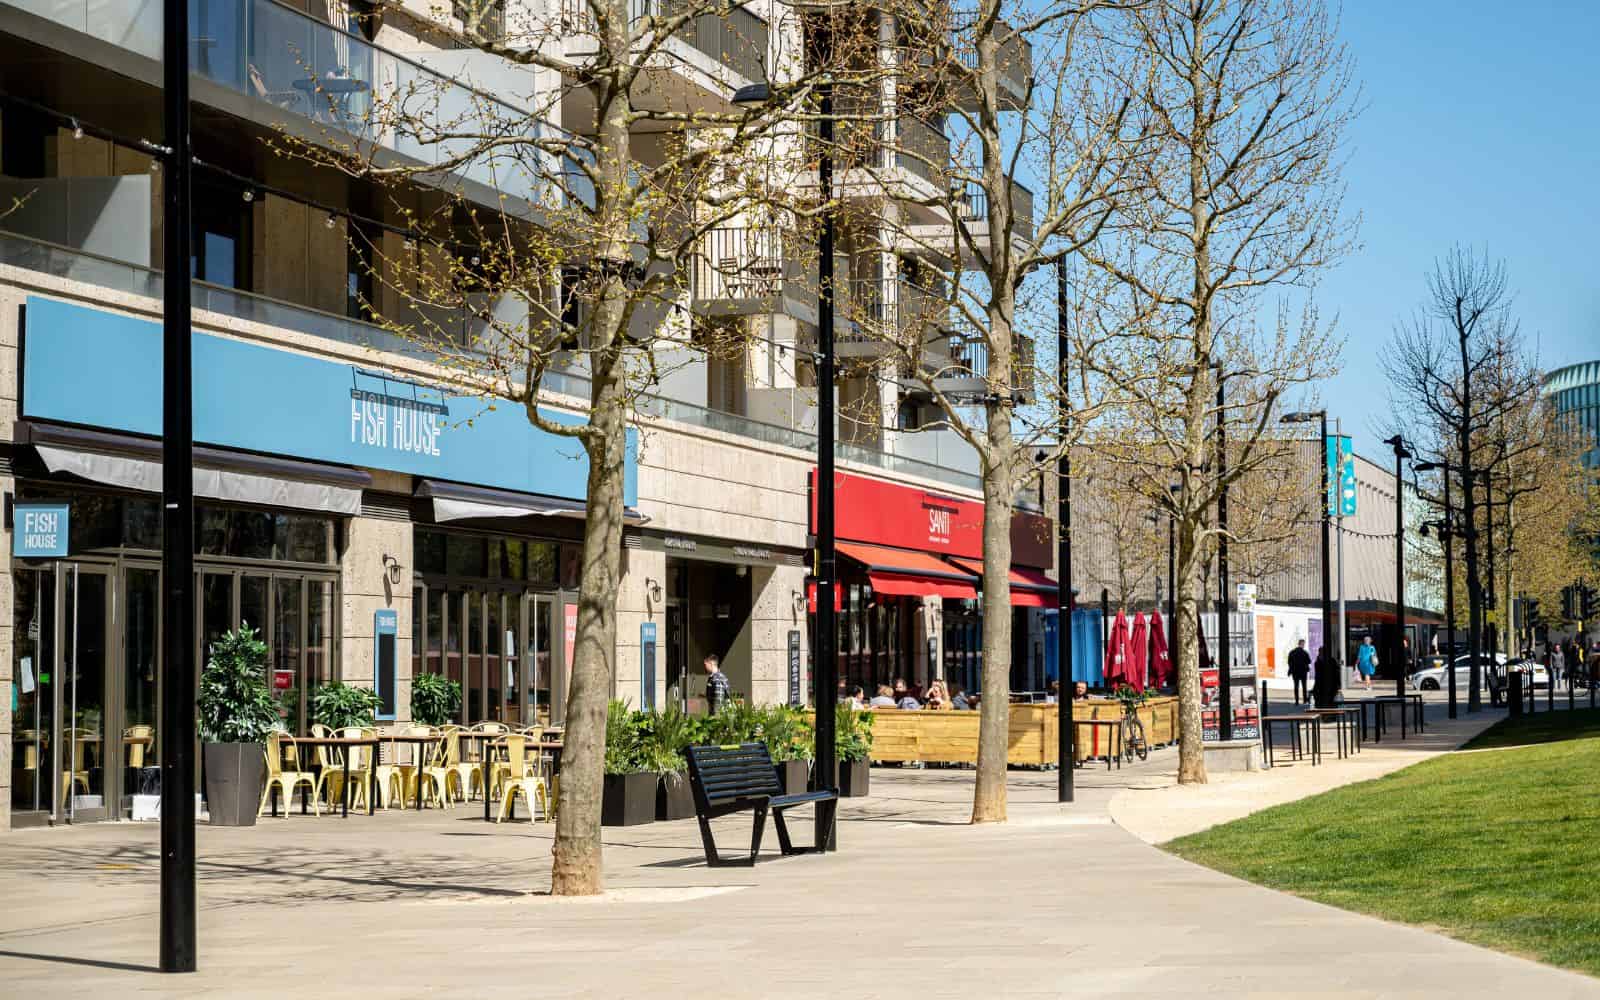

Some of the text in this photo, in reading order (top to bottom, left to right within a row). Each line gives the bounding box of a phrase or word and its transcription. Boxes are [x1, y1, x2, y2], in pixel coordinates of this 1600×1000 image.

[351, 391, 441, 457] FISH HOUSE
[25, 512, 58, 533] FISH
[929, 508, 950, 535] SANTI
[24, 534, 57, 549] HOUSE
